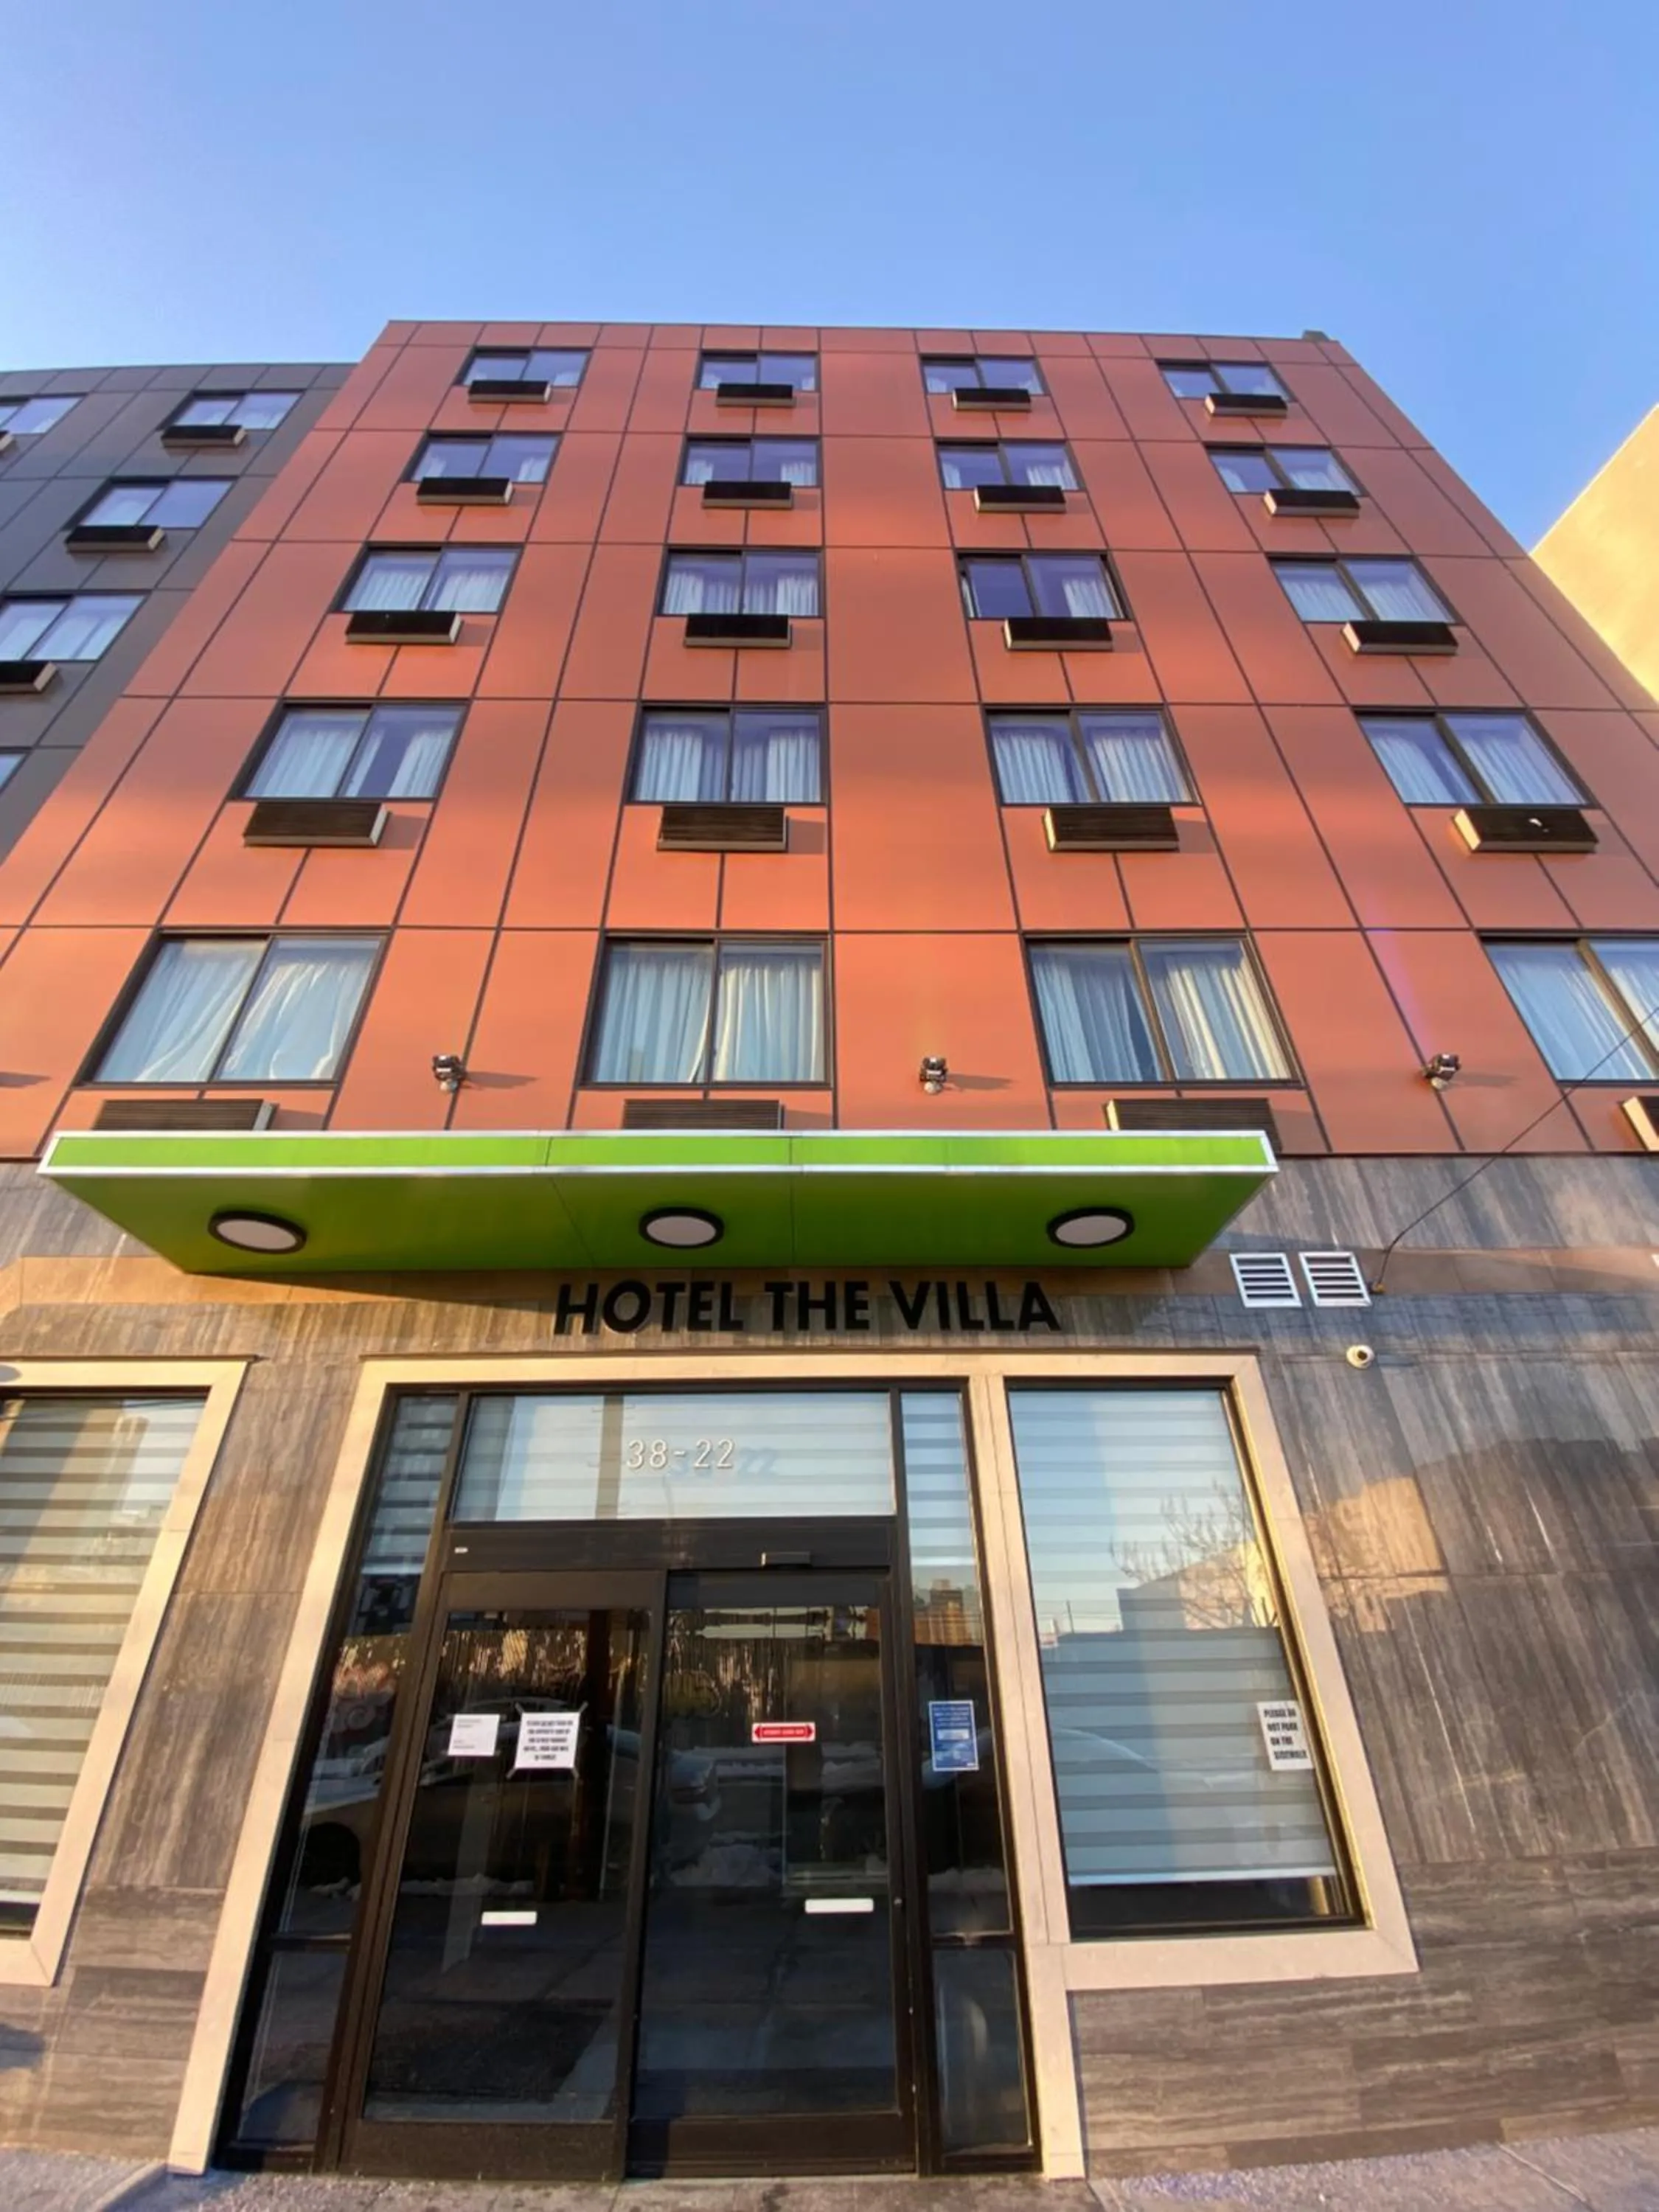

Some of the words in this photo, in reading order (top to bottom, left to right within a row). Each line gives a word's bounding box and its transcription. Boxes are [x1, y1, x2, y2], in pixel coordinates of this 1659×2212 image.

[554, 1280, 744, 1335] HOTEL
[765, 1281, 871, 1332] THE
[888, 1280, 1062, 1332] VILLA
[627, 1439, 735, 1469] 38-22
[1267, 1722, 1280, 1731] NOT
